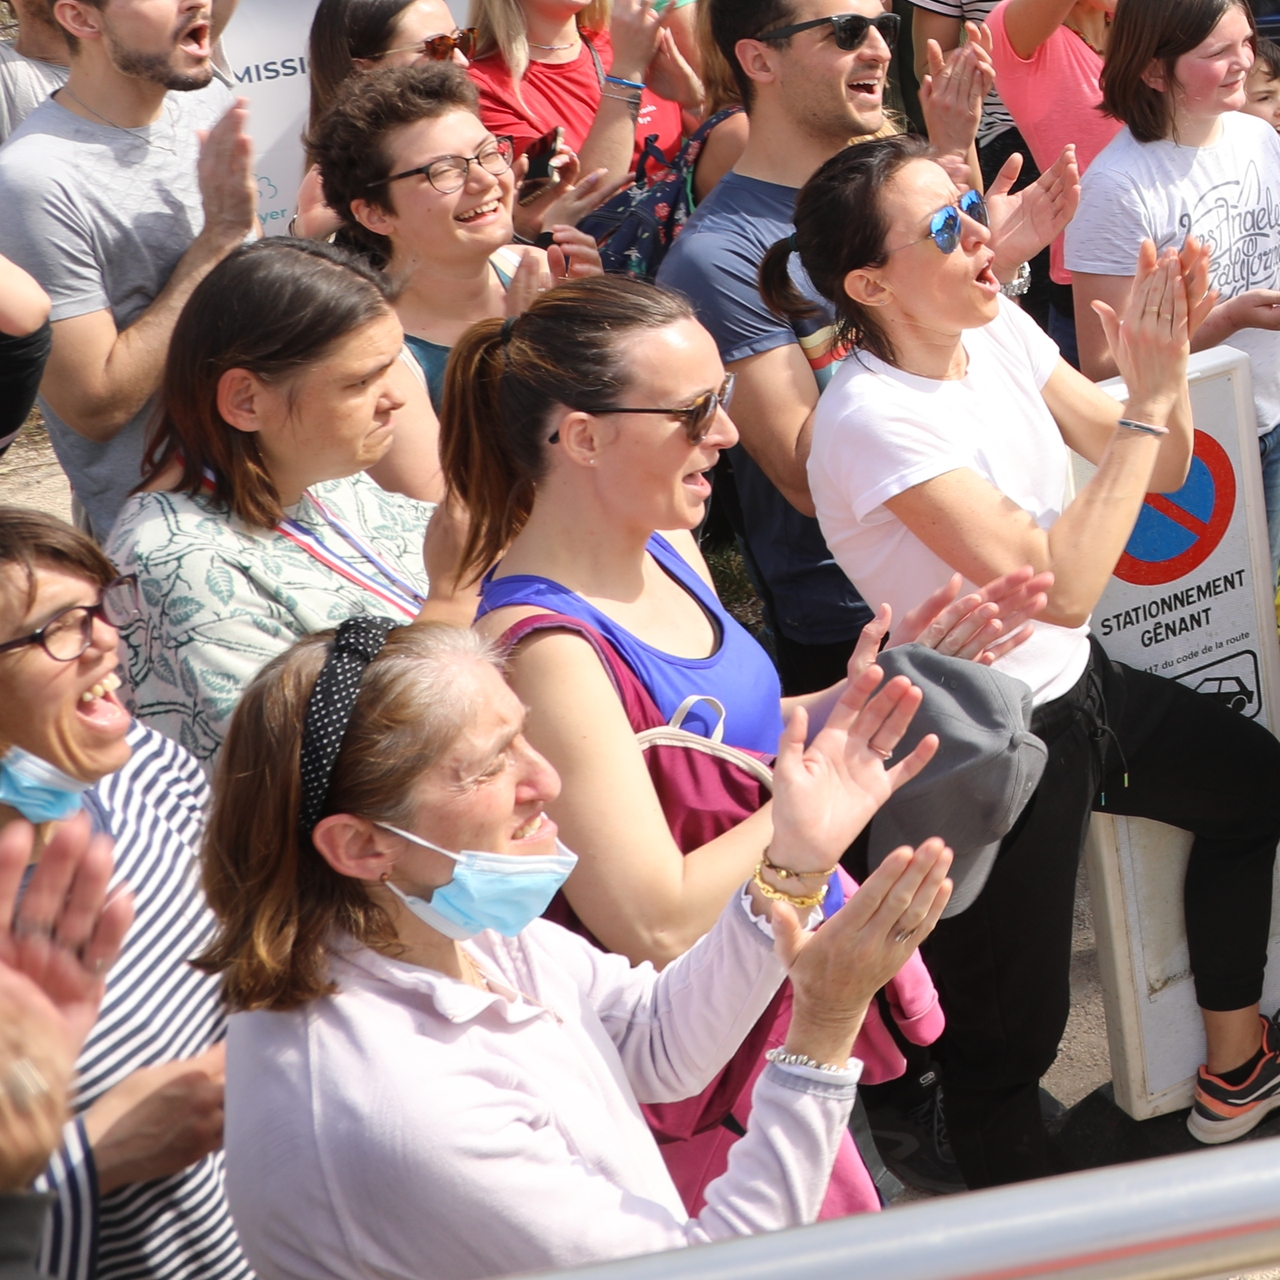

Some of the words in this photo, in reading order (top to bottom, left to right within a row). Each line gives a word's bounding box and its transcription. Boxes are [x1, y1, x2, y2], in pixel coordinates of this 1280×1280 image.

[232, 57, 306, 83] MISSI
[1101, 569, 1245, 636] STATIONNEMENT
[1141, 607, 1212, 648] GÊNANT
[1161, 659, 1174, 670] du
[1176, 648, 1199, 664] code
[1201, 643, 1213, 655] de
[1215, 641, 1224, 650] la
[1226, 631, 1250, 646] route
